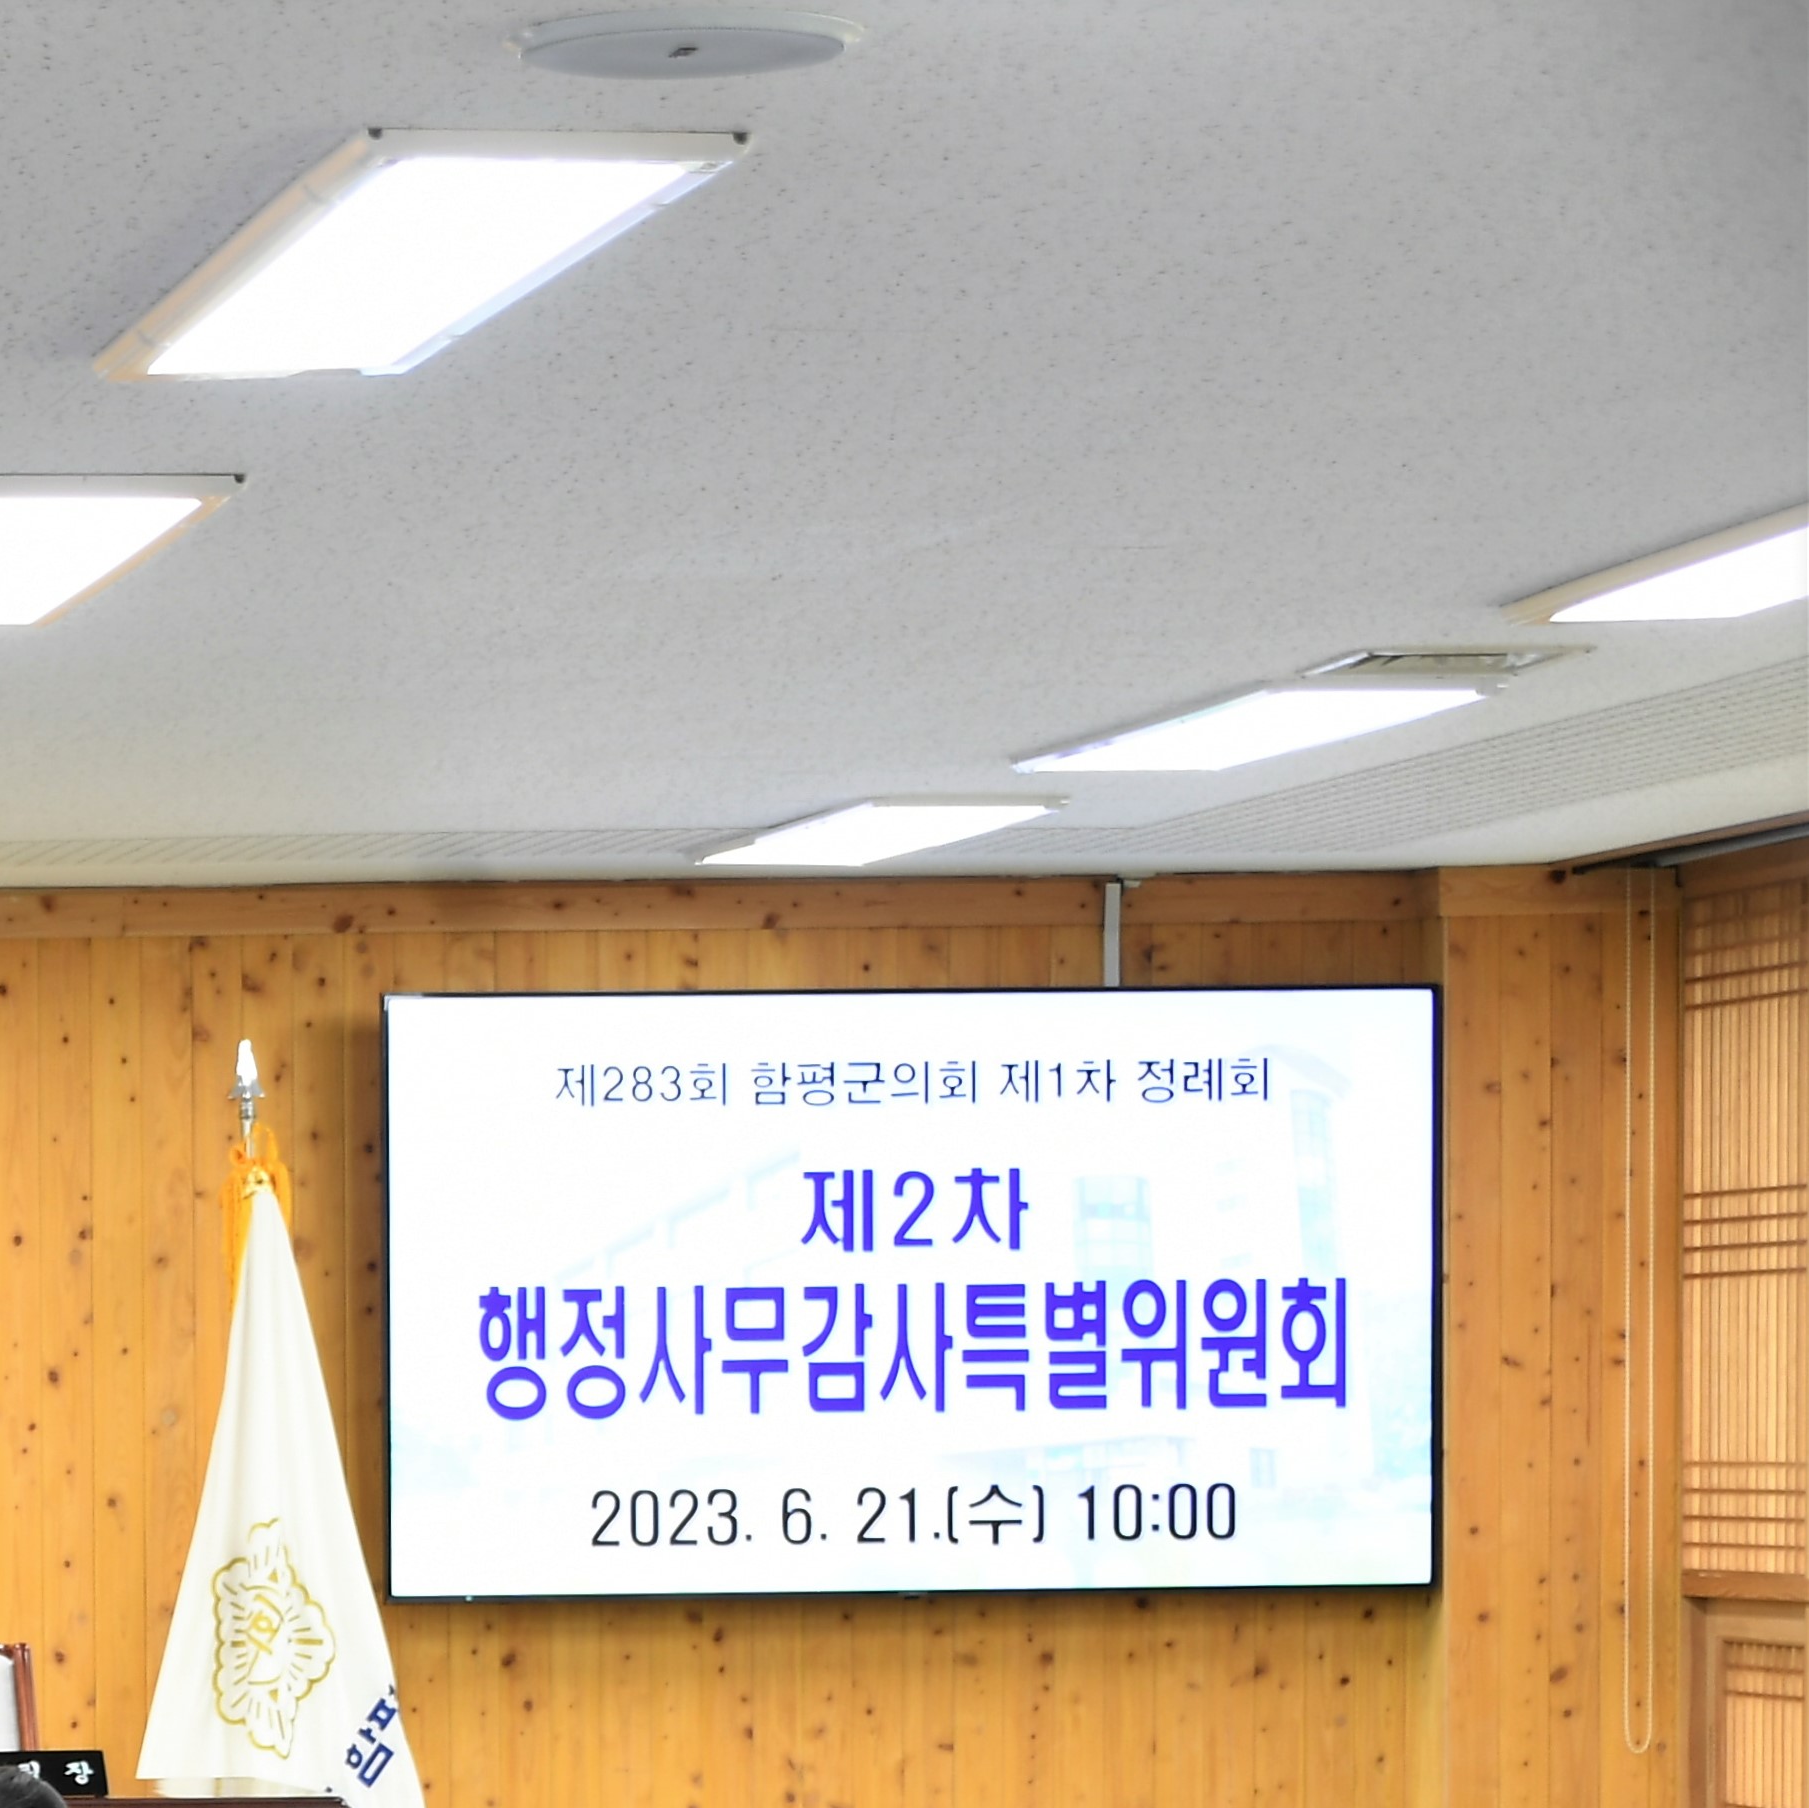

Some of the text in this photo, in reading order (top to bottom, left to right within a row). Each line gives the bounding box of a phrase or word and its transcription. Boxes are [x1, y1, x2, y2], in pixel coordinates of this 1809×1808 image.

[554, 1057, 1270, 1107] 제283회 함평군의회 제1차 정례회
[800, 1167, 1030, 1253] 제2차
[478, 1277, 1348, 1421] 행정사무감사특별위원회
[590, 1482, 1237, 1547] 2023. 6. 21.(수) 10:00
